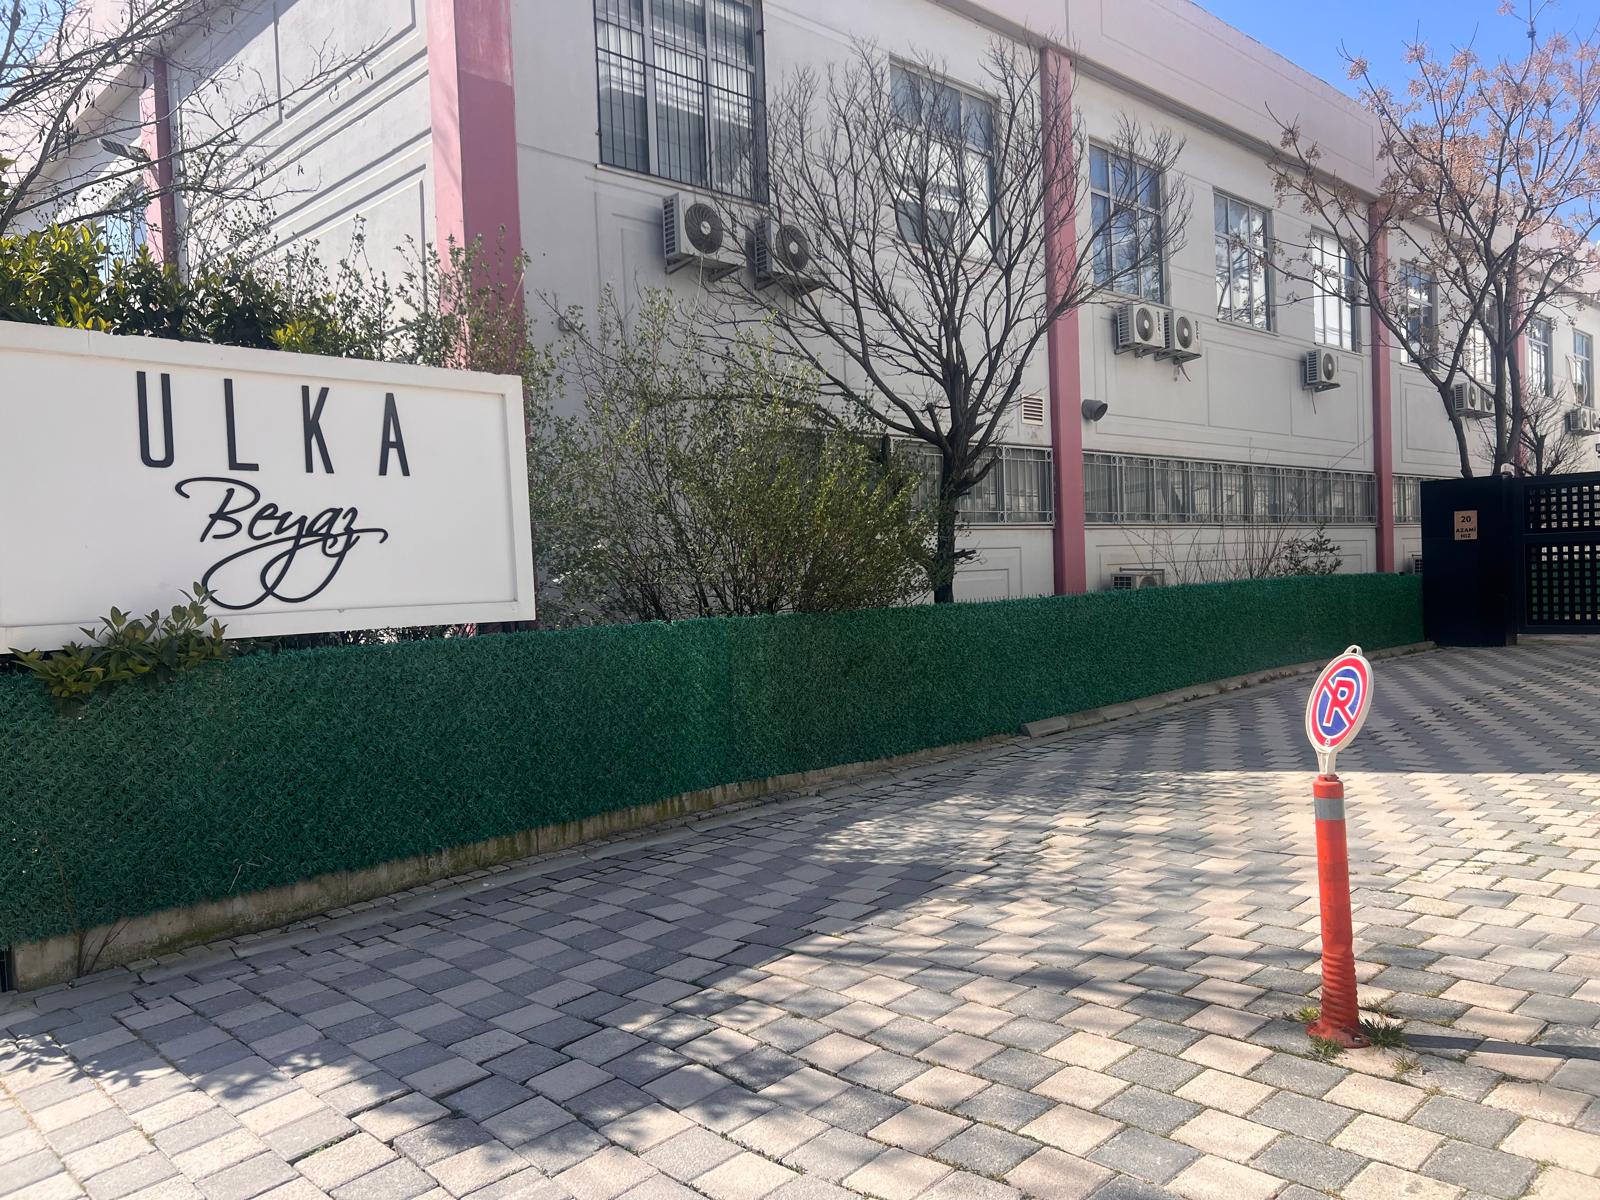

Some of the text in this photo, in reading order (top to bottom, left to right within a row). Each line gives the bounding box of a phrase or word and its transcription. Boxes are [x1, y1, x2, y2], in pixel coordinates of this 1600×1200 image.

[136, 371, 410, 476] ULKA
[175, 477, 388, 609] Beyaz
[1460, 515, 1472, 523] 20
